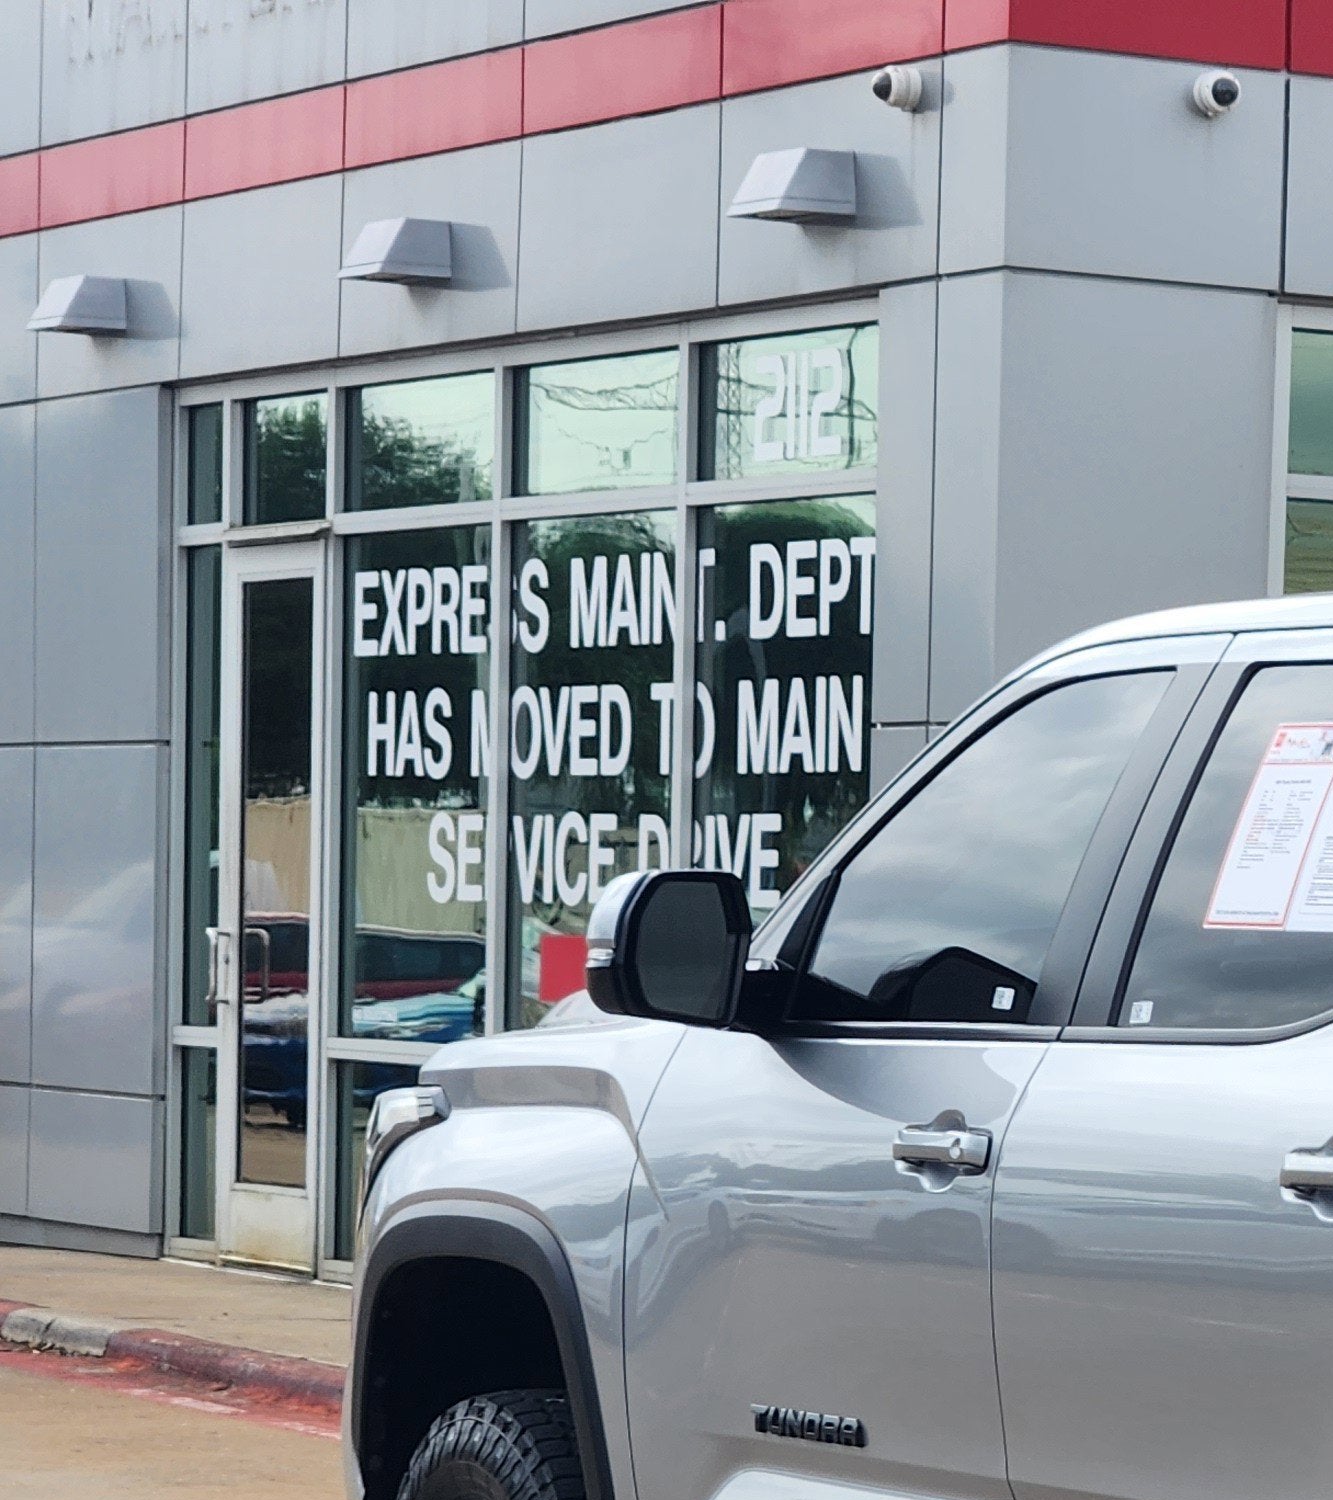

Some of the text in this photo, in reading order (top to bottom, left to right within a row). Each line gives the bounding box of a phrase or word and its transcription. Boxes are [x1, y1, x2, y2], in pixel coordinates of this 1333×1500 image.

[353, 557, 550, 657] EXPRES
[367, 686, 453, 780] HAS
[736, 674, 864, 776] MAIN
[426, 810, 782, 908] SEVICE DIVE
[750, 1403, 869, 1448] TUNDRA
